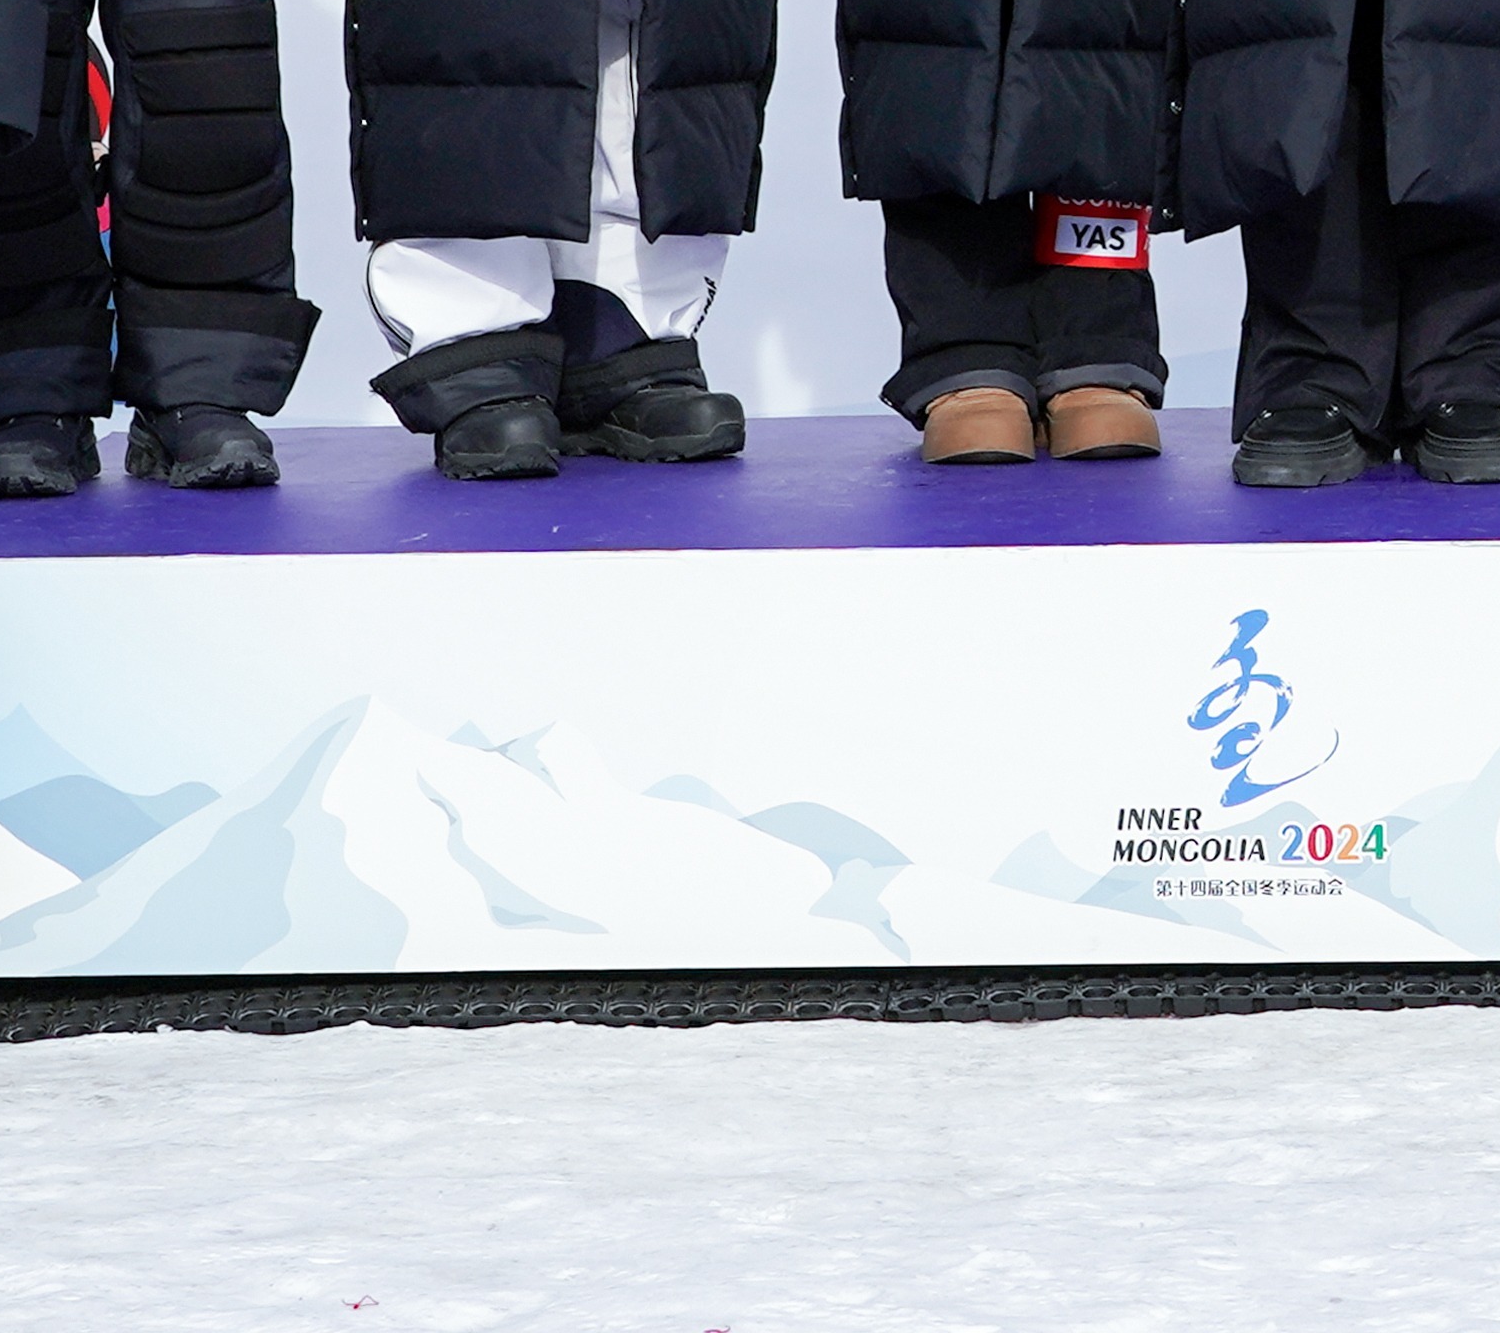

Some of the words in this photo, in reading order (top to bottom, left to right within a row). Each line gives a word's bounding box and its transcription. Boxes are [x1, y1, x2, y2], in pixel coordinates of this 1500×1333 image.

[1071, 222, 1126, 251] YAS
[1117, 807, 1203, 831] INNER
[1112, 838, 1266, 863] MONGOLIA
[1280, 823, 1388, 861] 2024
[1156, 878, 1344, 897] 第十四届全国冬季运动会
